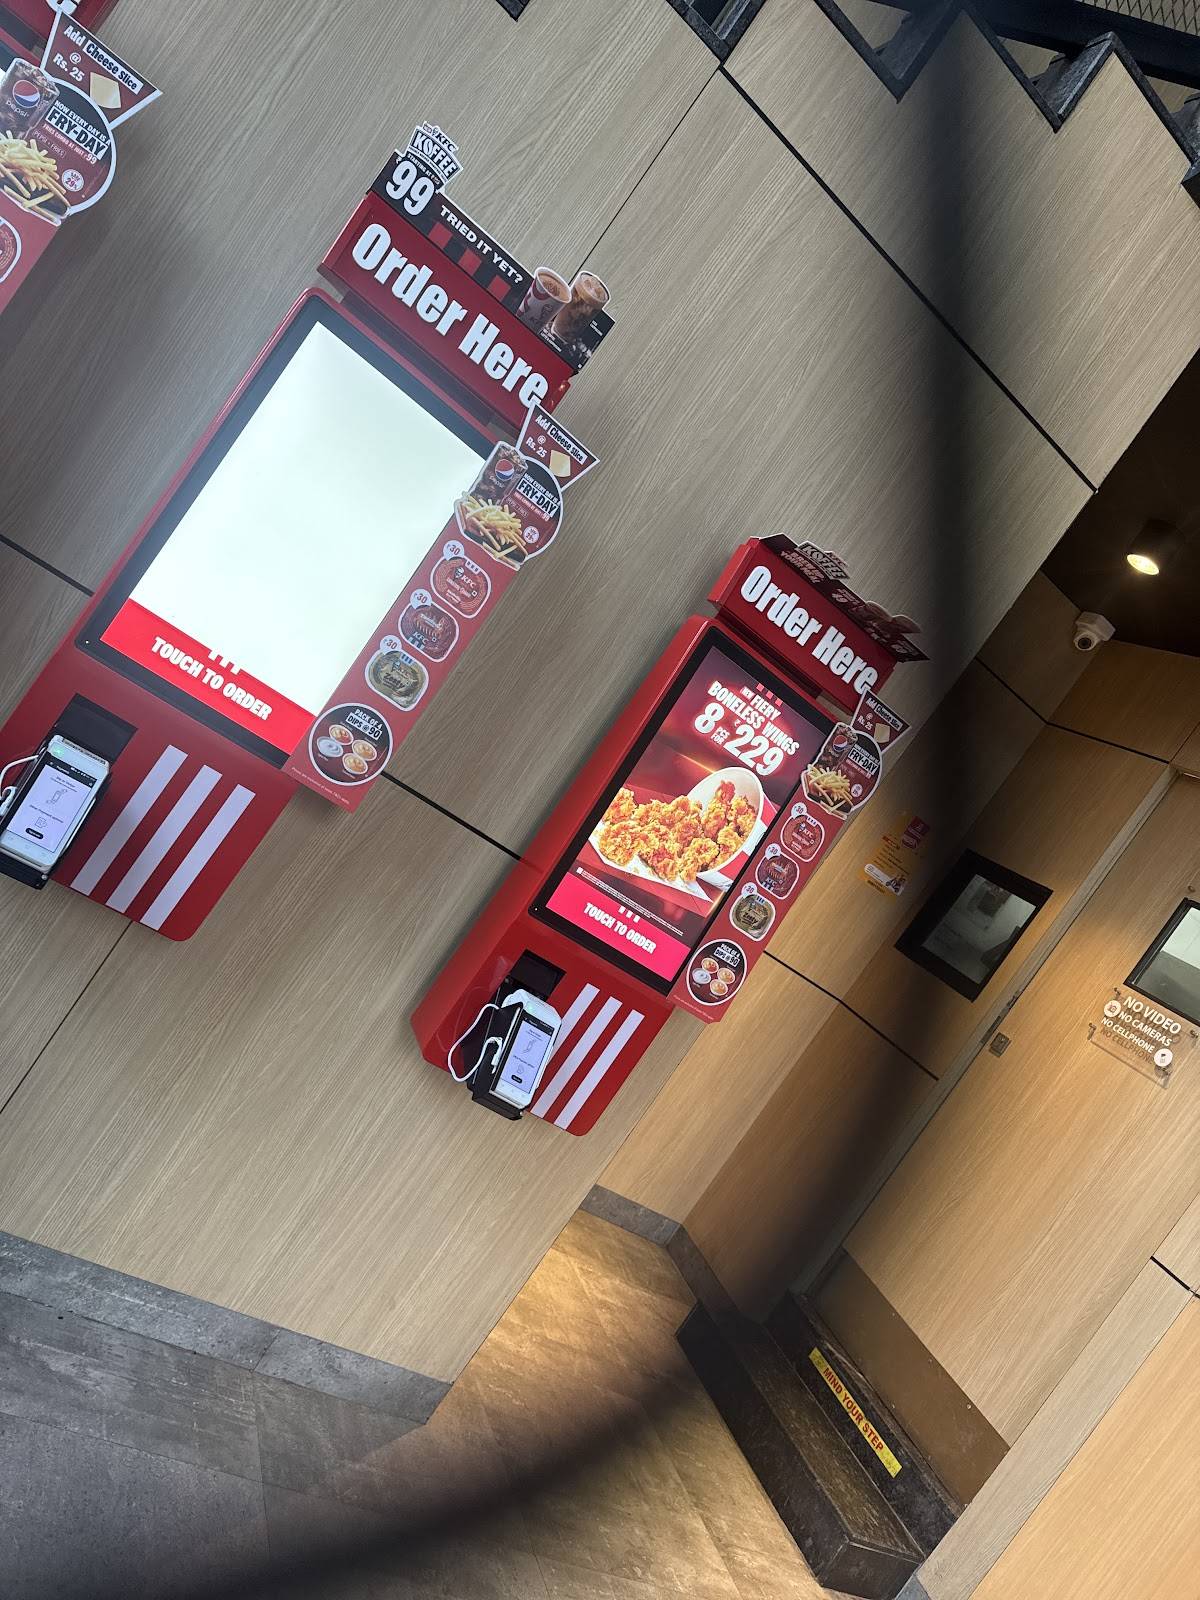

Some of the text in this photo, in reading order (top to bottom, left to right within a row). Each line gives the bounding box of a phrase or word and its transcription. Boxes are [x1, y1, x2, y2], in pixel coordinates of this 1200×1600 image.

[52, 53, 85, 82] Rs. 25
[64, 25, 137, 90] Add Cheese Slice
[70, 52, 82, 64] @
[48, 110, 106, 156] FRY-DAY
[54, 100, 70, 114] NOW
[68, 111, 89, 129] EVERY
[86, 124, 100, 138] DAY
[413, 132, 457, 177] KOFFEE
[436, 132, 456, 152] KFC
[407, 154, 426, 173] STARTING
[440, 205, 523, 284] TRIED IT YET?
[352, 223, 549, 409] Order Here
[526, 437, 548, 458] Rs. 25
[535, 415, 550, 430] Add
[550, 427, 572, 450] Cheese
[518, 481, 556, 514] FRY-DAY
[802, 546, 846, 579] KOFFEE
[461, 575, 476, 588] KFC
[413, 632, 428, 644] KFC
[740, 566, 878, 696] Order Here
[151, 636, 273, 720] TOUCH TO ORDER
[354, 709, 372, 723] PACK
[370, 718, 379, 726] OF
[694, 702, 725, 734] 8
[707, 680, 800, 755] BONELESS WINGS
[750, 695, 781, 721] FIERY
[348, 715, 362, 728] DIPS
[368, 727, 381, 739] 90
[865, 721, 873, 730] 25
[849, 750, 878, 774] FRY-DAY
[583, 902, 657, 954] TOUCH TO ORDER
[1118, 1011, 1172, 1046] NO CAMERAS
[1123, 996, 1181, 1034] NO VIDEO
[1101, 1017, 1155, 1053] NO CELLPHONE
[823, 1368, 884, 1450] MIND YOUR STEP
